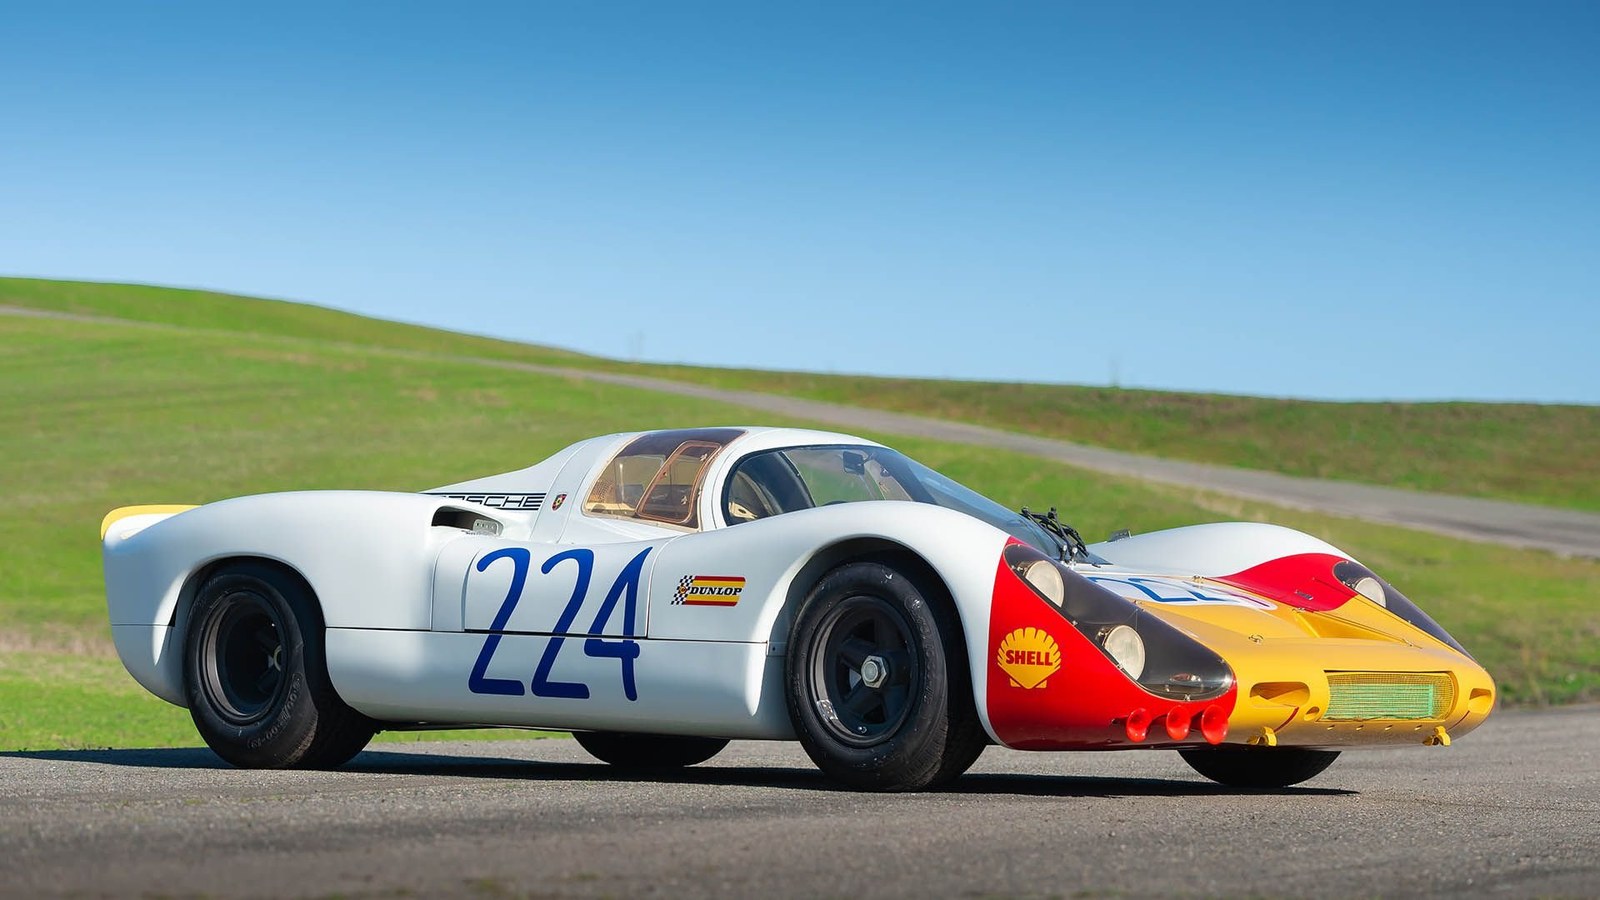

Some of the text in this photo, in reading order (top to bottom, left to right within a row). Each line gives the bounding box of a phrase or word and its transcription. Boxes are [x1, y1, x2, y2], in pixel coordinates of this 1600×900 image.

[443, 495, 546, 507] SCHE
[689, 586, 742, 596] DUNLOP
[468, 546, 653, 702] 224
[1005, 649, 1053, 666] SHELL
